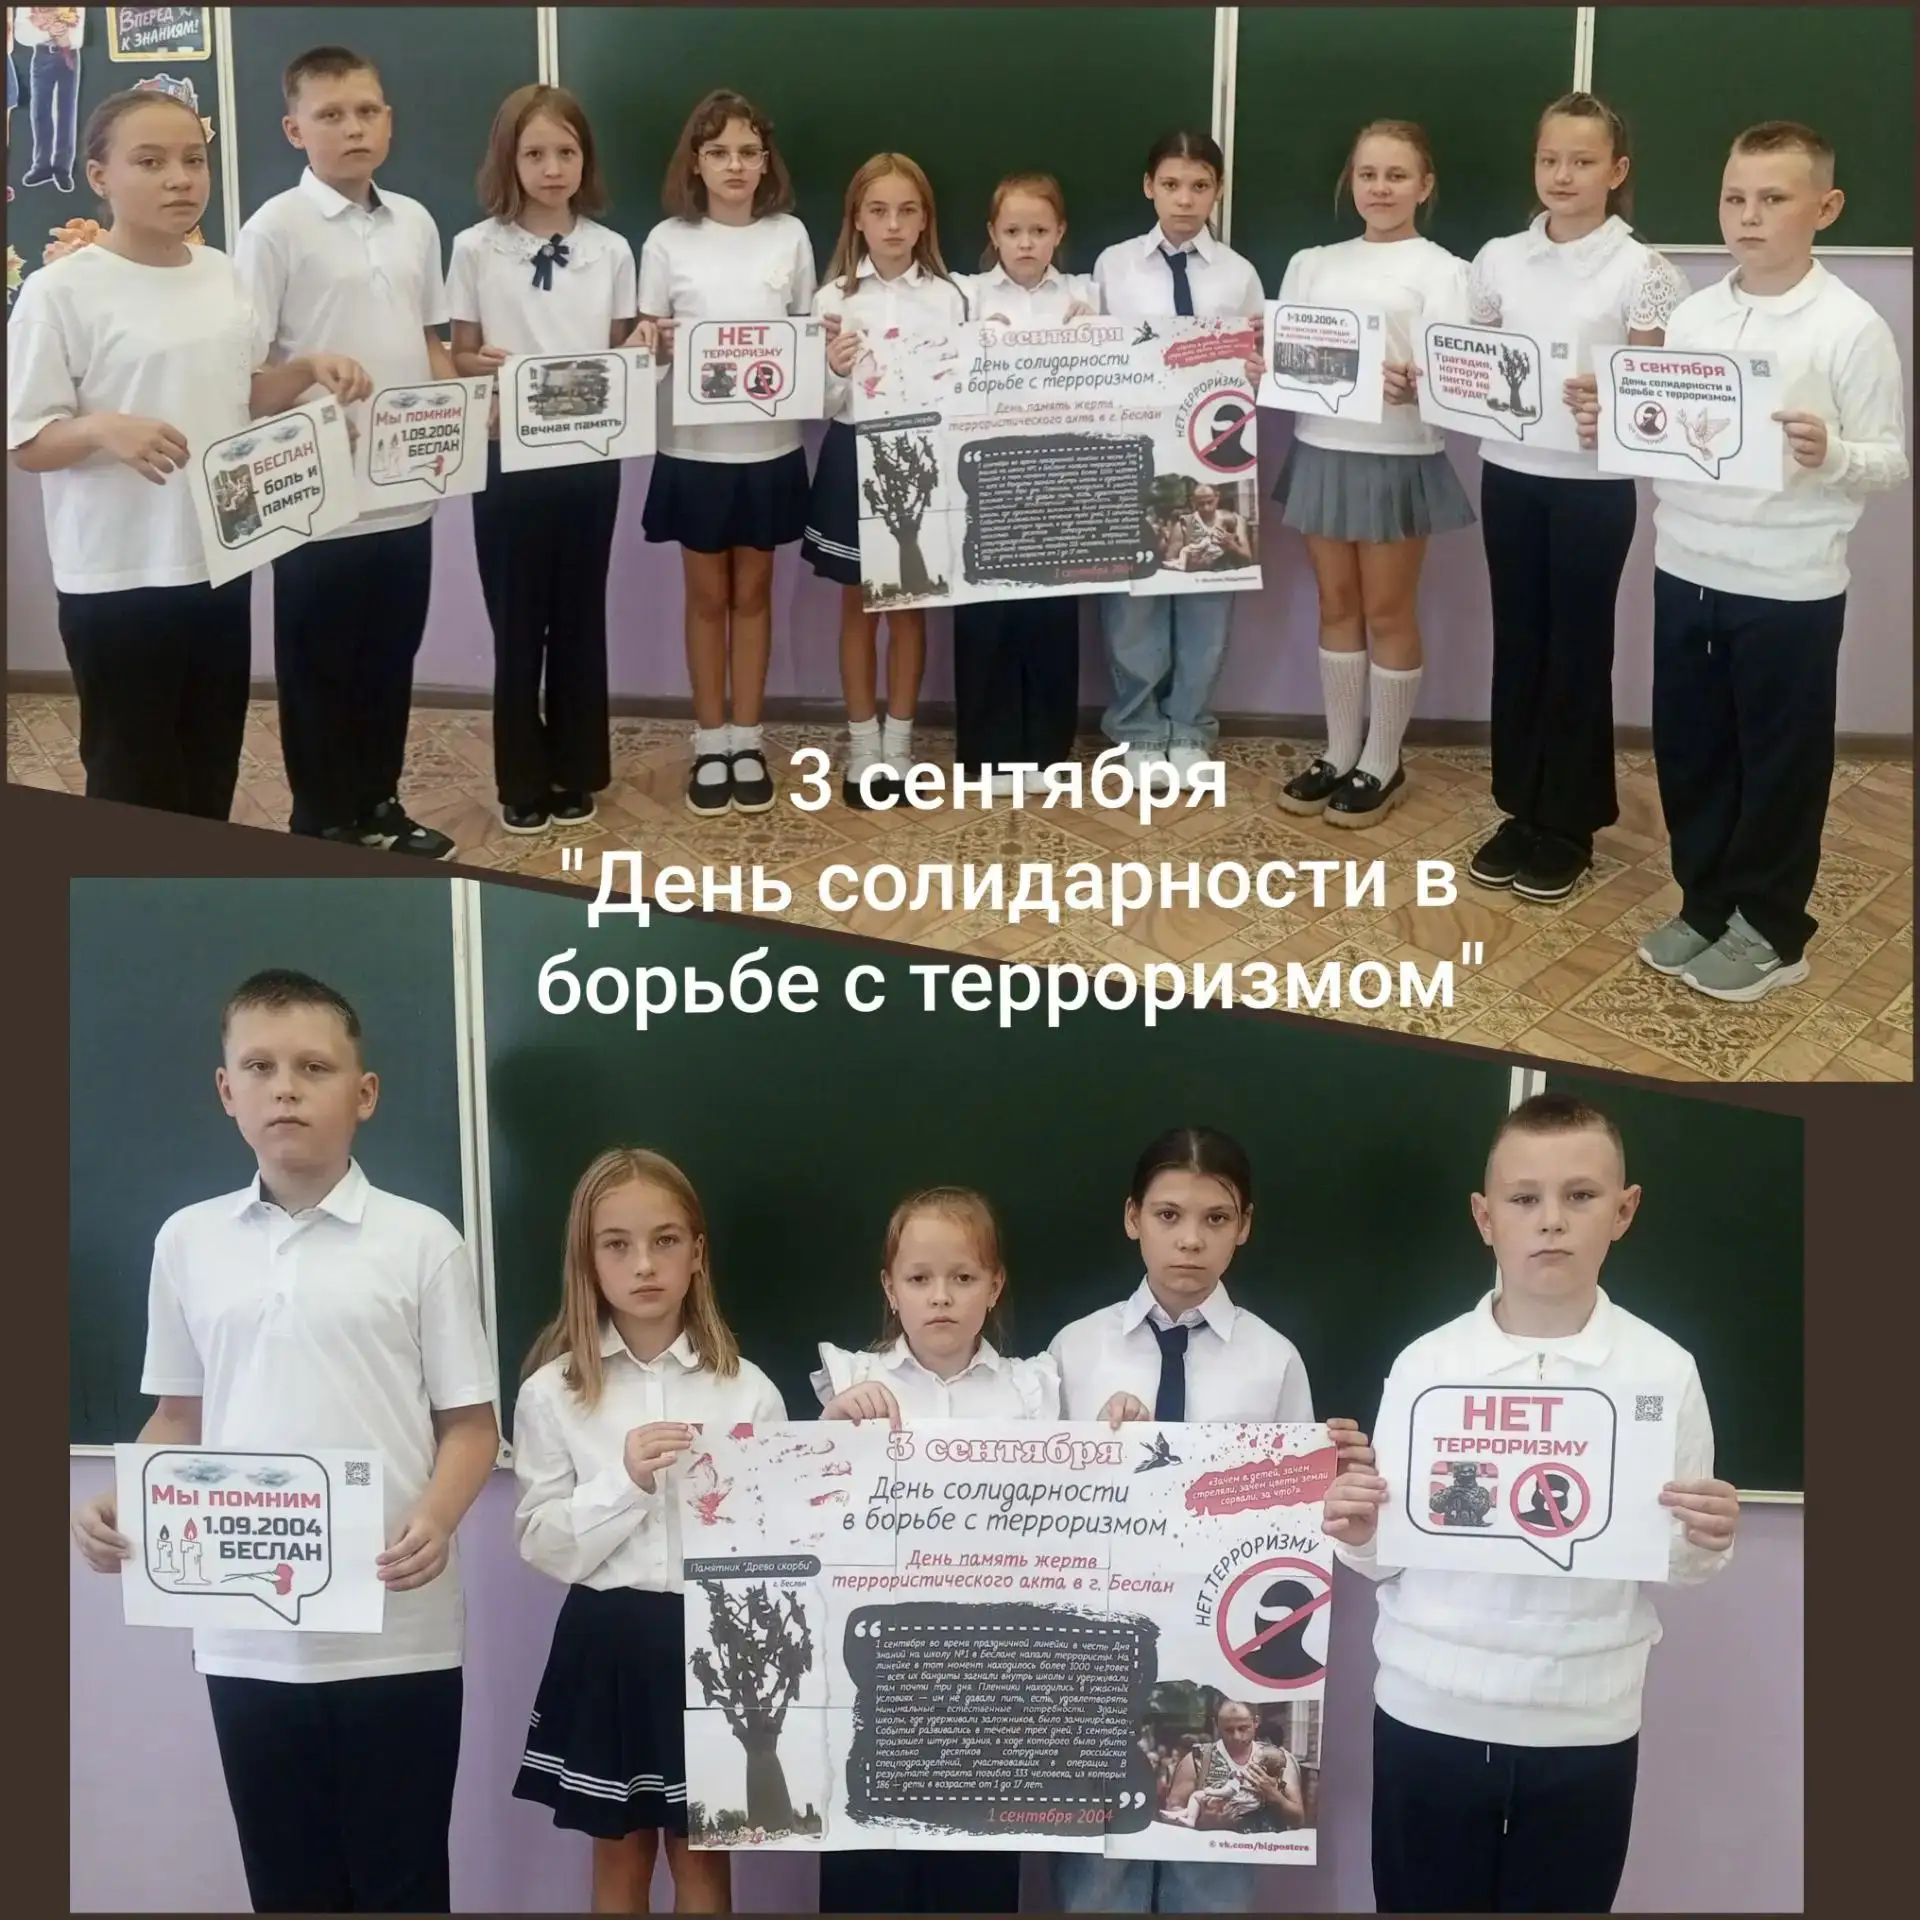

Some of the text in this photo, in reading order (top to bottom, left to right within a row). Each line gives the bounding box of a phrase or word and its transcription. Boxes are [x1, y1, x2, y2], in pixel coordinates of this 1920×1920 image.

[121, 19, 199, 51] К ЗНАНИЯМ!
[718, 326, 770, 345] НЕТ
[978, 323, 1123, 347] 3 сентября
[703, 348, 783, 359] ТЕРРОРИЗМУ
[1433, 335, 1497, 356] БЕСЛАН
[969, 353, 1129, 375] День солидарности
[1435, 352, 1493, 371] Трагедия,
[1624, 359, 1726, 378] 3 сентября
[1439, 364, 1489, 380] которую
[954, 372, 1154, 394] в борьбе с терроризмом
[1439, 374, 1491, 390] никто не
[1621, 376, 1733, 392] День солидарности в
[1179, 376, 1246, 413] ТЕРРОРИЗМУ
[1442, 385, 1489, 400] забудет
[1619, 386, 1654, 397] борьбе
[1666, 390, 1736, 402] терроризмом
[376, 407, 462, 427] Мы помним
[1175, 414, 1185, 438] НЕТ
[402, 424, 460, 442] 1.09.2004
[521, 417, 622, 437] Вечная память
[408, 439, 460, 458] БЕСЛАН
[253, 441, 314, 477] БЕСЛАН
[263, 465, 318, 497] боль и
[262, 485, 321, 517] память
[1463, 1396, 1563, 1432] НЕТ
[886, 1429, 1124, 1470] 3 сентября
[1433, 1437, 1588, 1456] ТЕРРОРИЗМУ
[1269, 1477, 1299, 1488] цветы
[1302, 1472, 1328, 1482] земли
[152, 1485, 321, 1509] Мы помним
[869, 1477, 1129, 1512] День солидарности
[203, 1516, 322, 1537] 1.09.2004
[843, 1508, 1167, 1537] в борьбе с терроризмом
[220, 1540, 322, 1561] БЕСЛАН
[690, 1562, 740, 1573] Памятник
[906, 1549, 1098, 1572] День память жертв
[1204, 1533, 1319, 1591] ТЕРРОРИЗМУ
[780, 1580, 807, 1588] Беслан
[832, 1572, 1174, 1593] террористического акта в г. Беслан
[1196, 1589, 1213, 1628] НЕТ
[884, 1639, 1130, 1651] сентября время праздничной линейки честь Дня
[876, 1650, 906, 1659] знаний
[924, 1650, 951, 1660] школу
[980, 1650, 1016, 1658] Беслане
[876, 1661, 910, 1670] линейке
[987, 1662, 1036, 1673] находилось
[1040, 1661, 1066, 1670] более
[1070, 1662, 1090, 1670] 1000
[1094, 1664, 1129, 1672] человек
[887, 1673, 905, 1681] всех
[921, 1671, 960, 1684] бандиты
[1001, 1673, 1033, 1681] внутрь
[1077, 1674, 1128, 1685] удерживали
[978, 1682, 1020, 1691] Пленники
[1025, 1684, 1074, 1695] находились
[1090, 1684, 1128, 1693] ужасных
[876, 1695, 1128, 1706] условиях давали удовлетворять
[1038, 1715, 1060, 1723] было
[876, 1726, 915, 1735] События
[919, 1727, 971, 1735] развивались
[1086, 1726, 1127, 1735] сентября
[1099, 1737, 1127, 1747] убито
[941, 1749, 980, 1759] десятков
[1003, 1749, 1059, 1759] сотрудников
[1080, 1749, 1127, 1757] российских
[876, 1770, 930, 1779] результате
[933, 1770, 972, 1778] теракта
[976, 1768, 1011, 1778] погибло
[1014, 1769, 1028, 1777] 333
[903, 1781, 924, 1792] дети
[935, 1781, 976, 1789] возрасте
[1000, 1808, 1073, 1825] сентября
[1077, 1808, 1113, 1823] 2004
[1219, 1841, 1310, 1851] vk.com/bigposters
